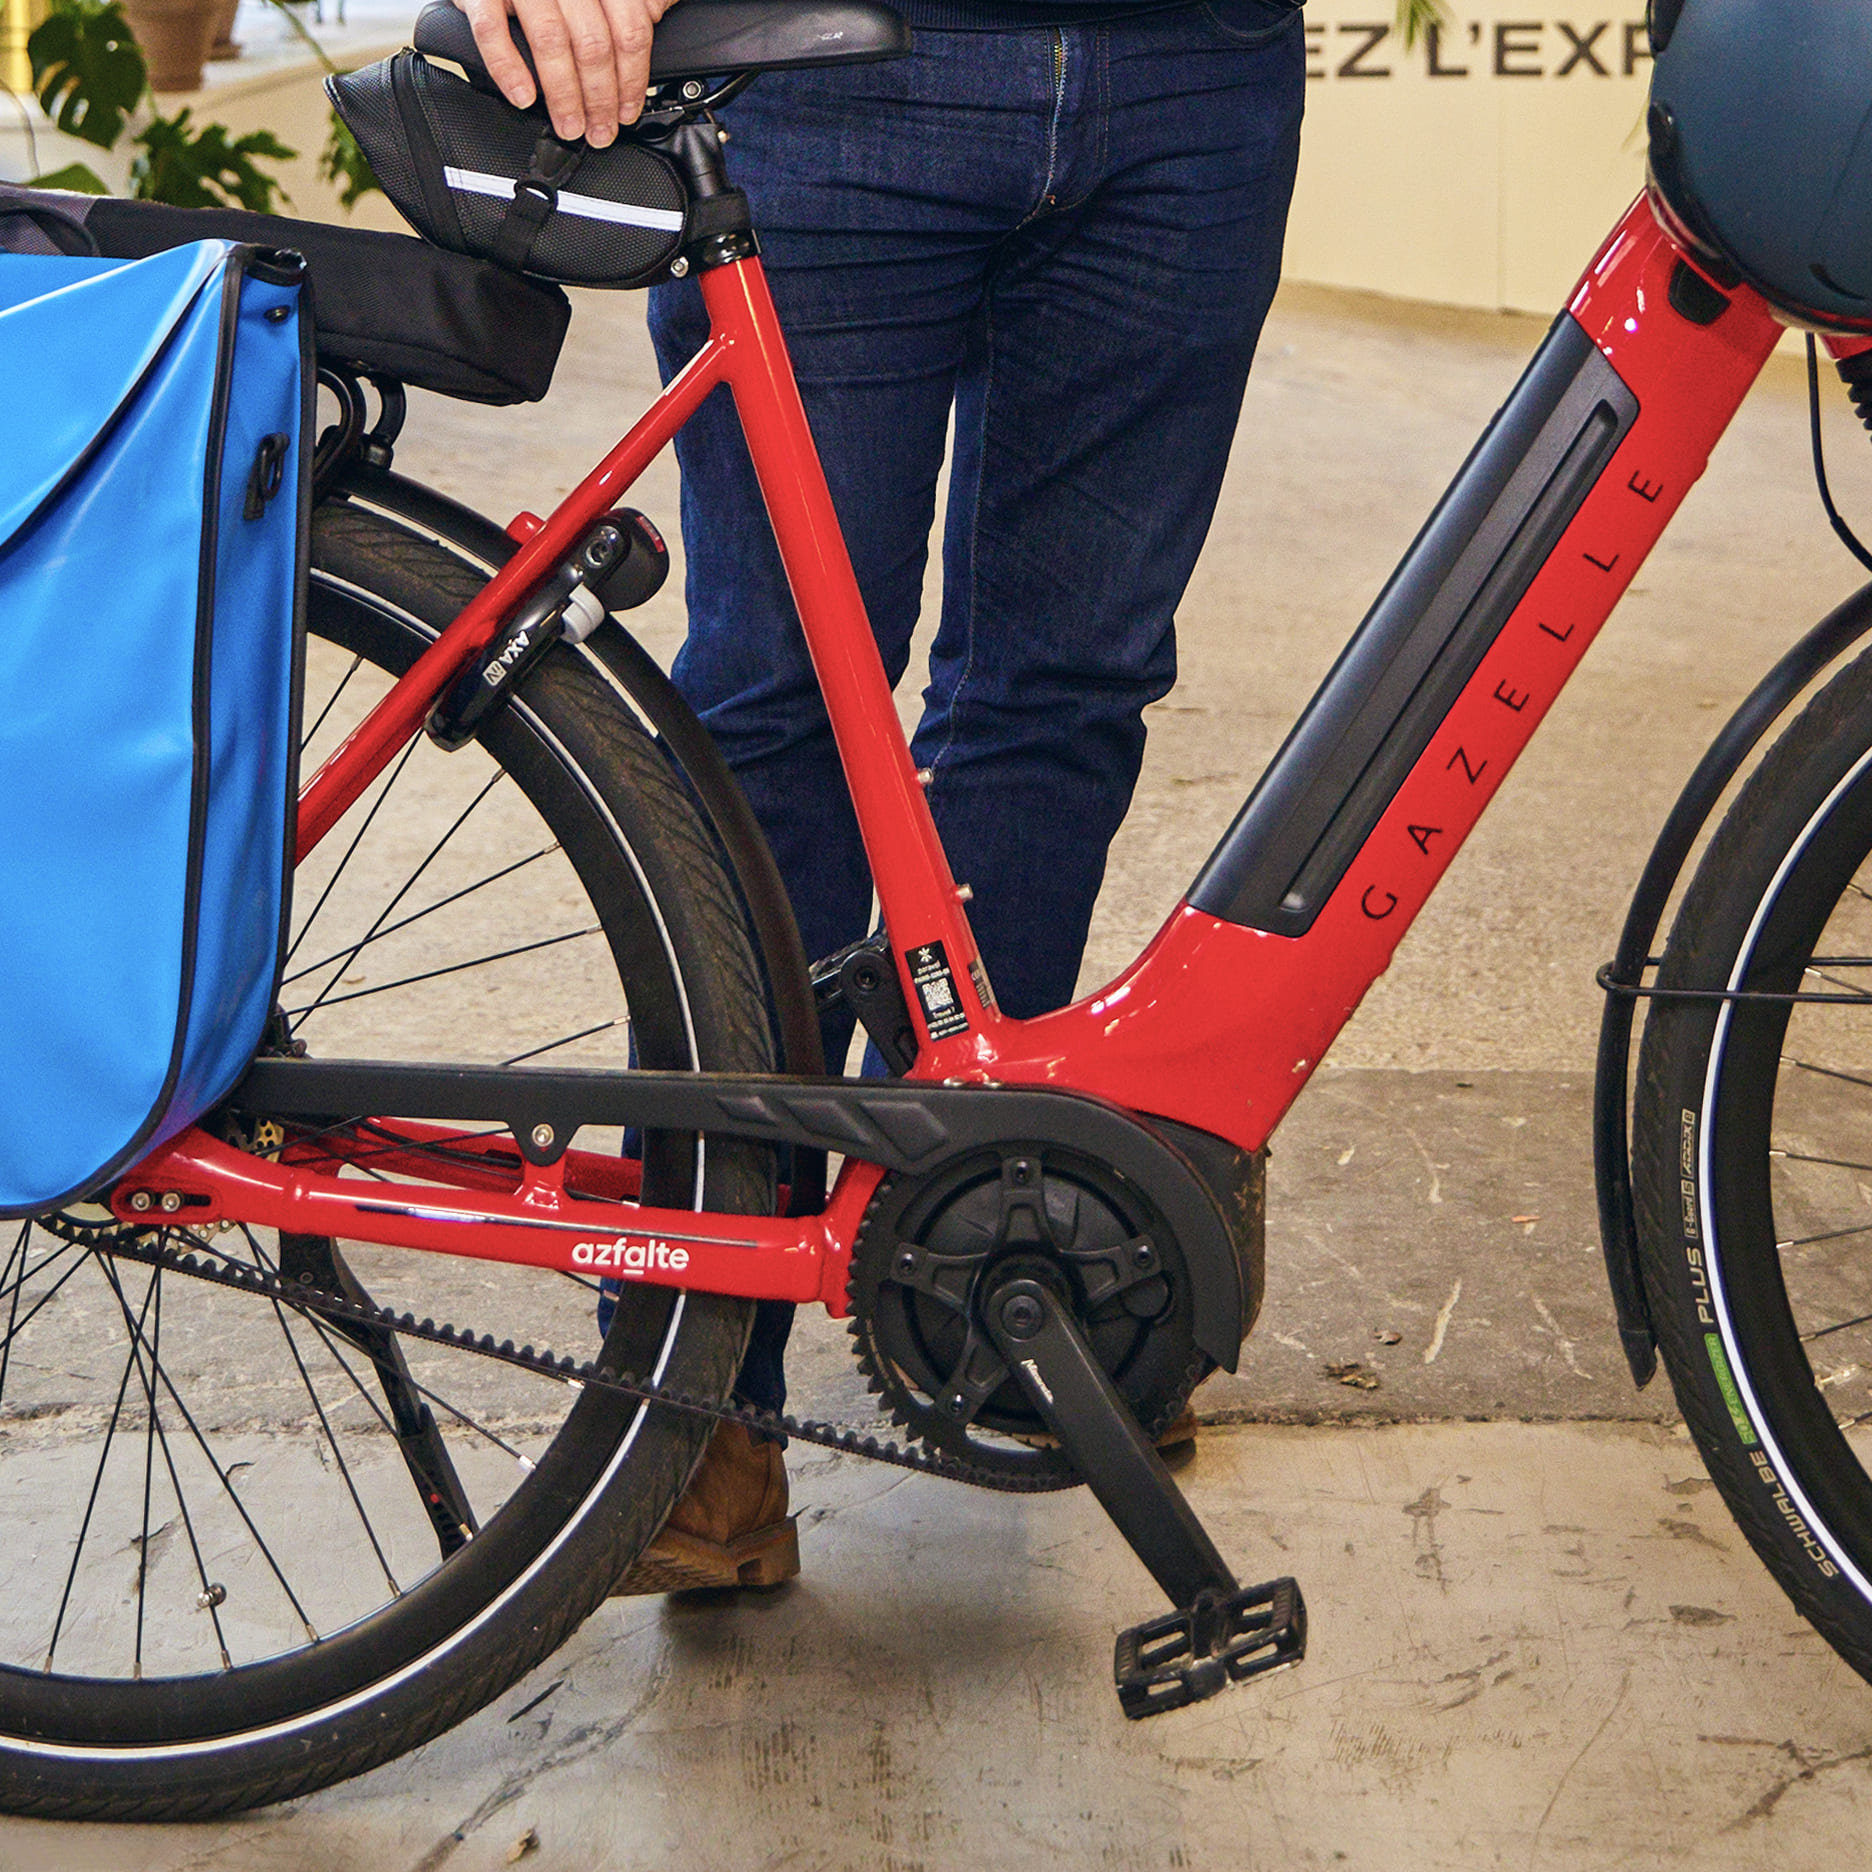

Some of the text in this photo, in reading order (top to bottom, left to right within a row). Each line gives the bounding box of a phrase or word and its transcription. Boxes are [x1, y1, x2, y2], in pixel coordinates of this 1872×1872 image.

[1360, 469, 1664, 921] GAZELLE
[572, 1237, 690, 1275] azfalte
[1687, 1246, 1715, 1324] PLUS
[1748, 1449, 1839, 1577] SCHWALBE
